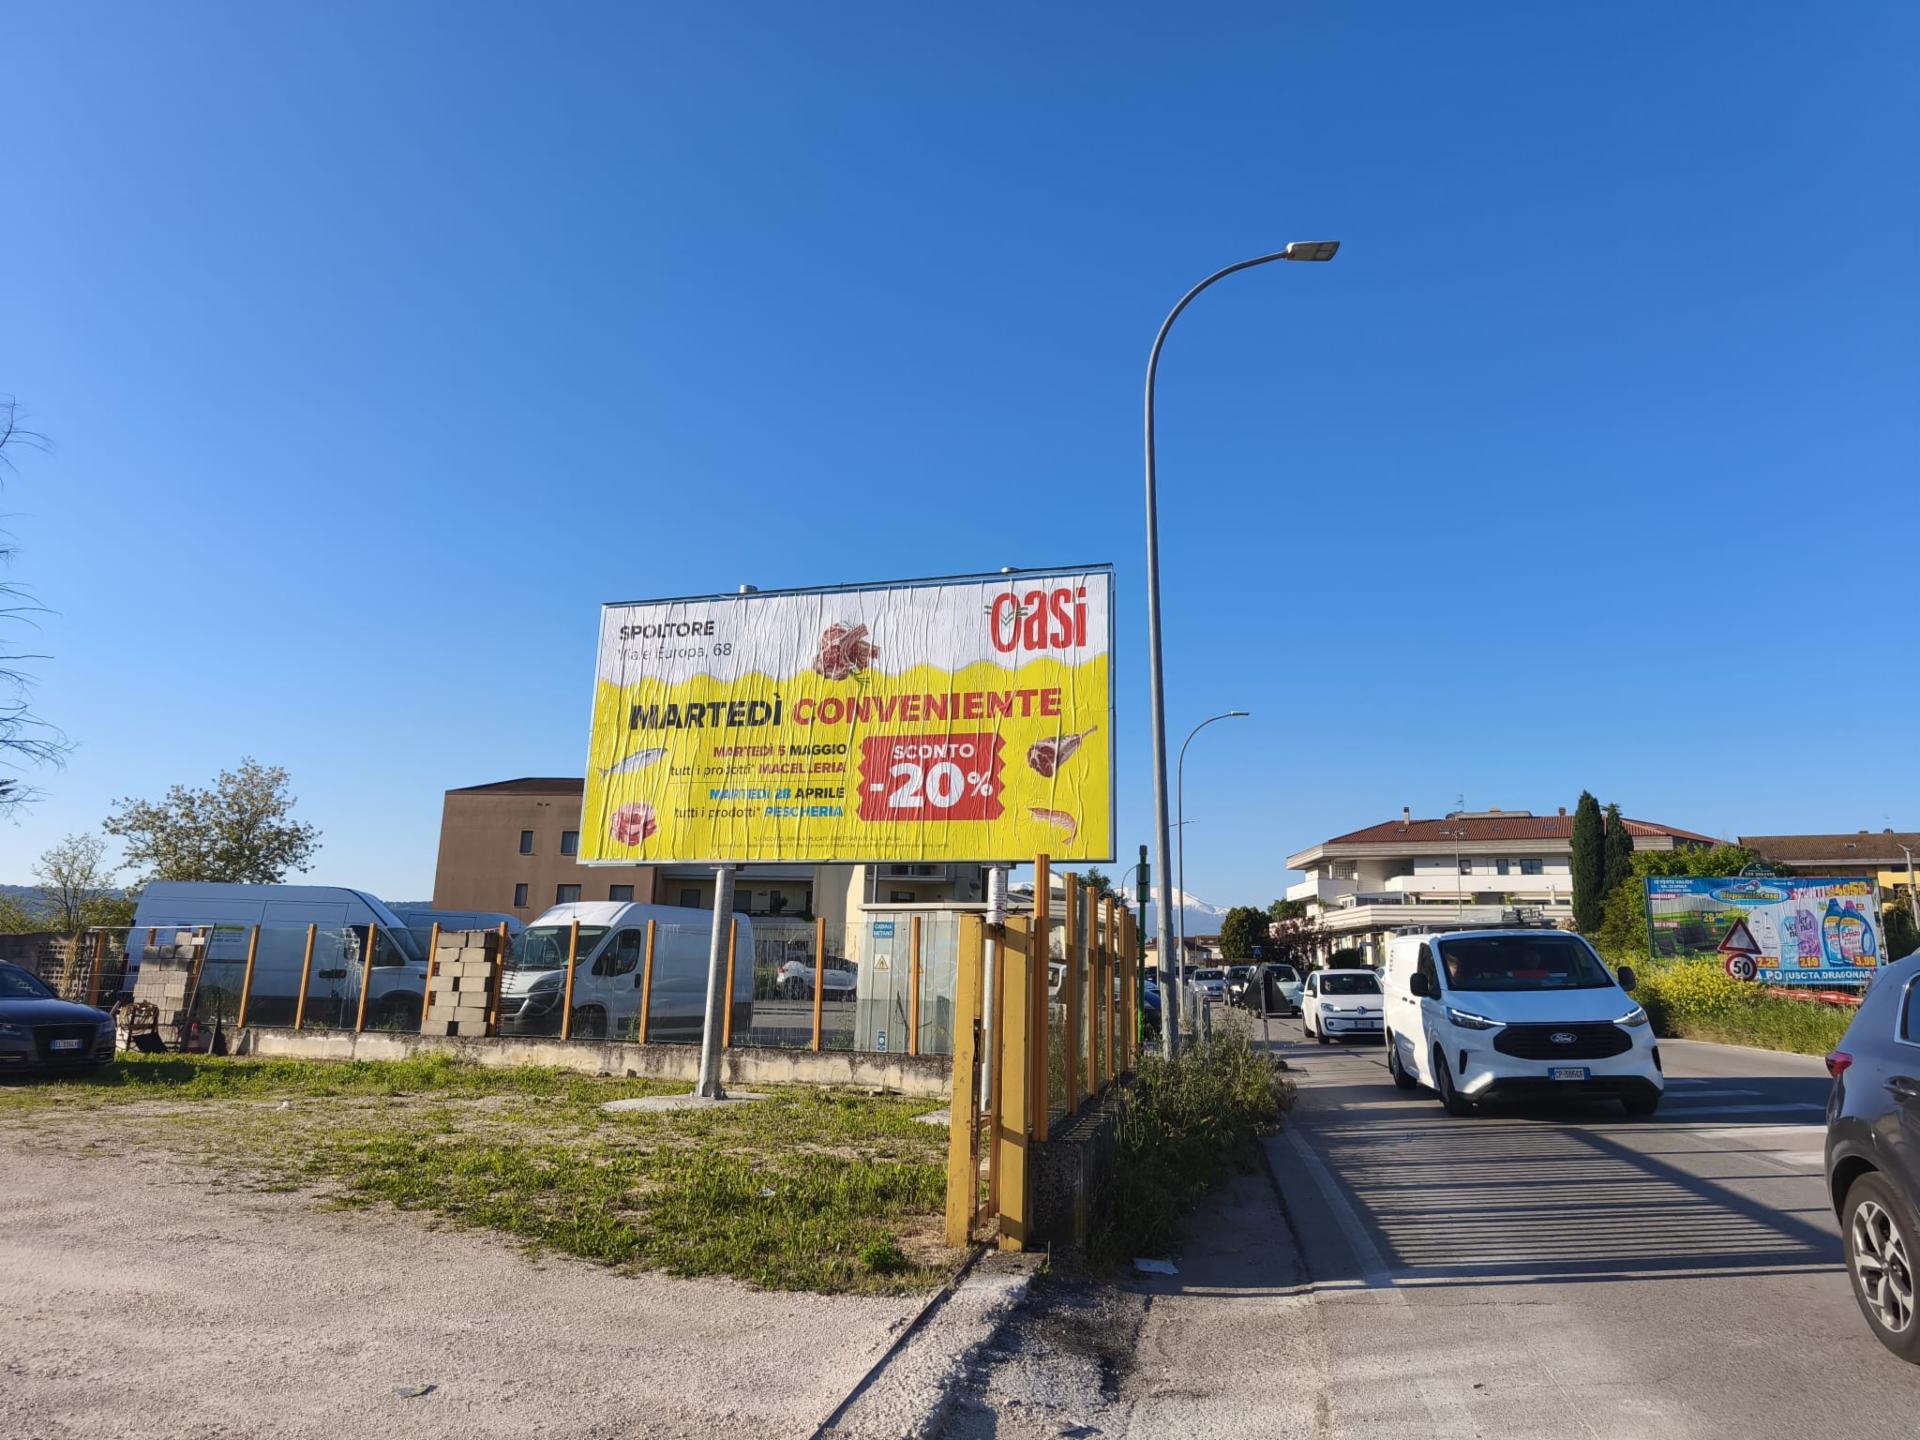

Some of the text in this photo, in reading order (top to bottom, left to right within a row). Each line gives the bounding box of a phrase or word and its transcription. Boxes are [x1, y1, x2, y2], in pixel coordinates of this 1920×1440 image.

[991, 587, 1086, 653] Oasi
[620, 621, 715, 640] SPOLTORE
[618, 648, 651, 660] Viae
[713, 642, 732, 656] 68
[630, 688, 1062, 730] MARTEDÌ CONVENIENTE
[778, 745, 786, 757] 5
[789, 743, 847, 756] MAGGIO
[893, 743, 975, 759] SCONTO
[759, 762, 846, 775] MACELLERIA
[775, 788, 792, 800] 28
[795, 787, 845, 799] APRILE
[765, 805, 843, 818] PESCHERIA
[1733, 960, 1751, 976] 50
